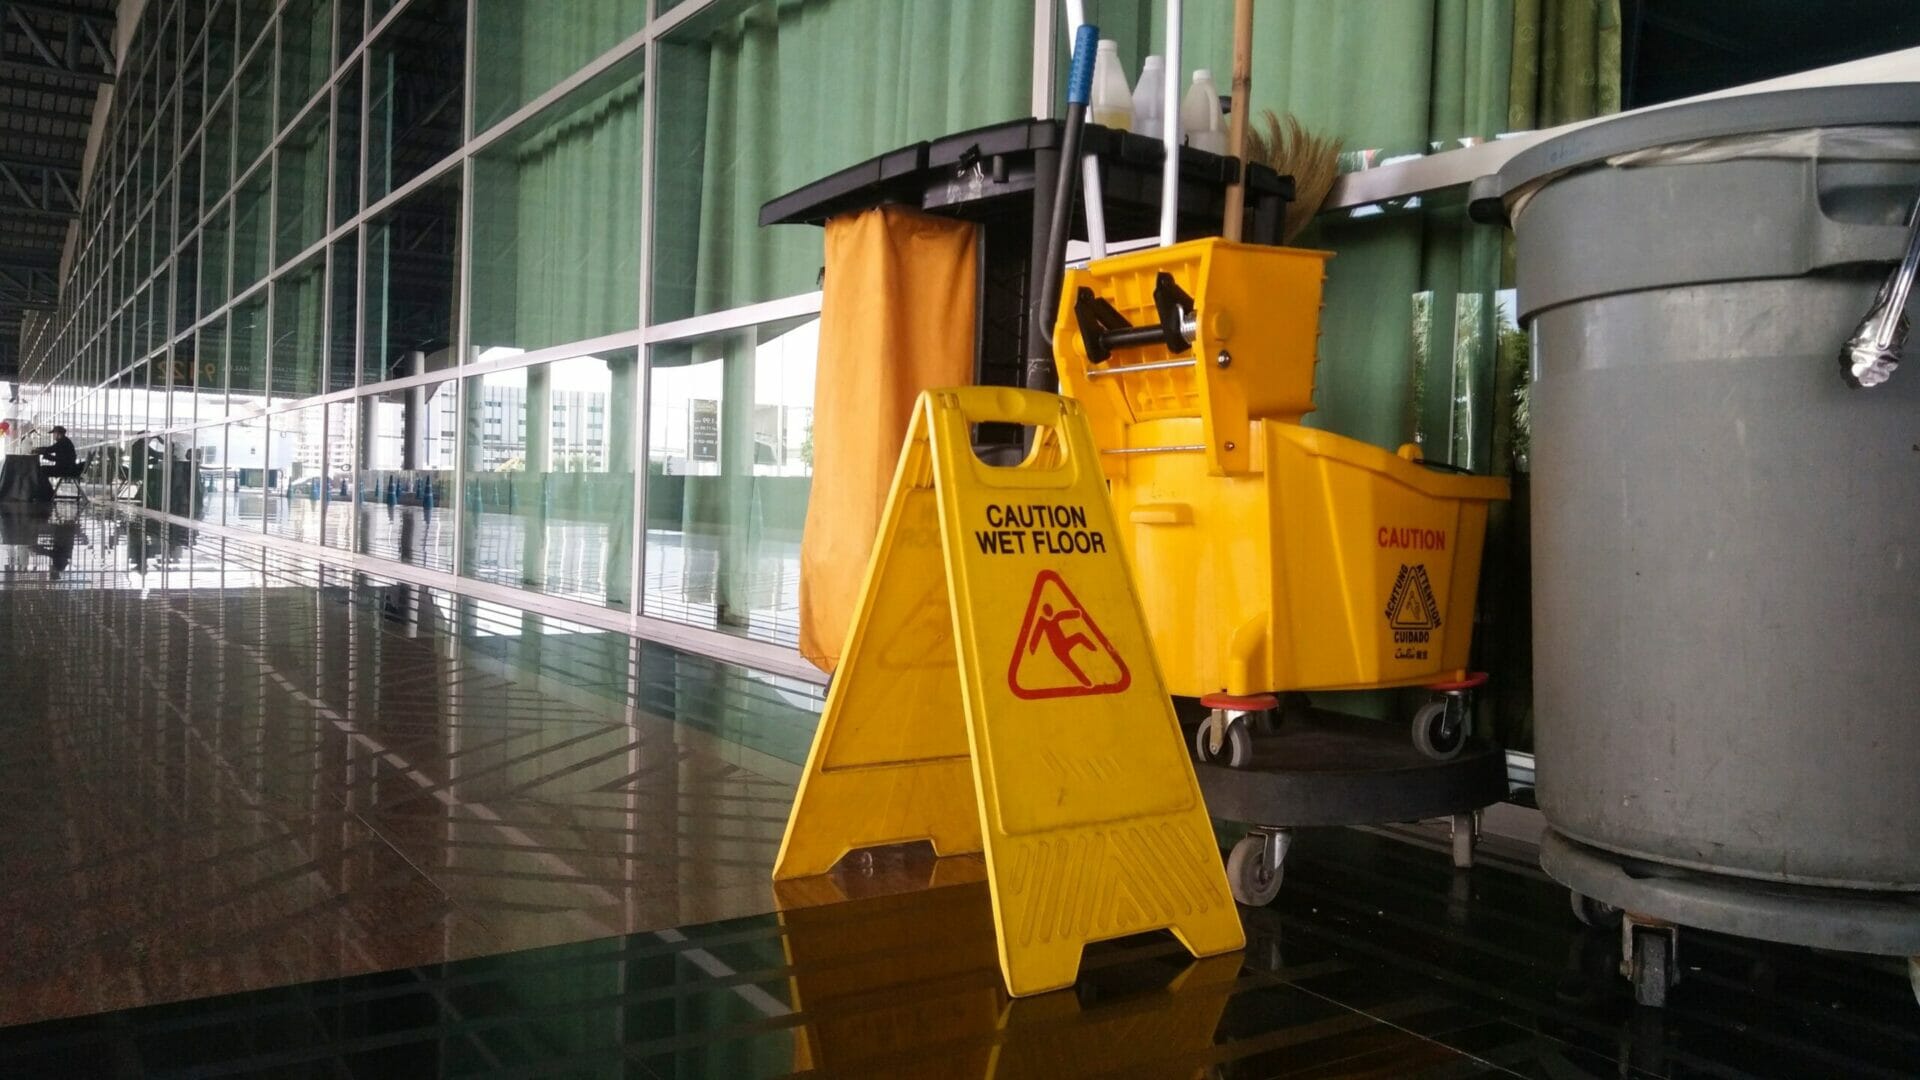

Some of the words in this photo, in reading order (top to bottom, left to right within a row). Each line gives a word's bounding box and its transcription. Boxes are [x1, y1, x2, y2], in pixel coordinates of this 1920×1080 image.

[986, 504, 1087, 528] CAUTION
[975, 530, 1027, 554] WET
[1031, 530, 1107, 554] FLOOR
[1377, 526, 1446, 550] CAUTION
[1384, 563, 1409, 620] ACHTUNG
[1415, 563, 1442, 629] ATTENTION
[1394, 631, 1429, 643] CUIDADO
